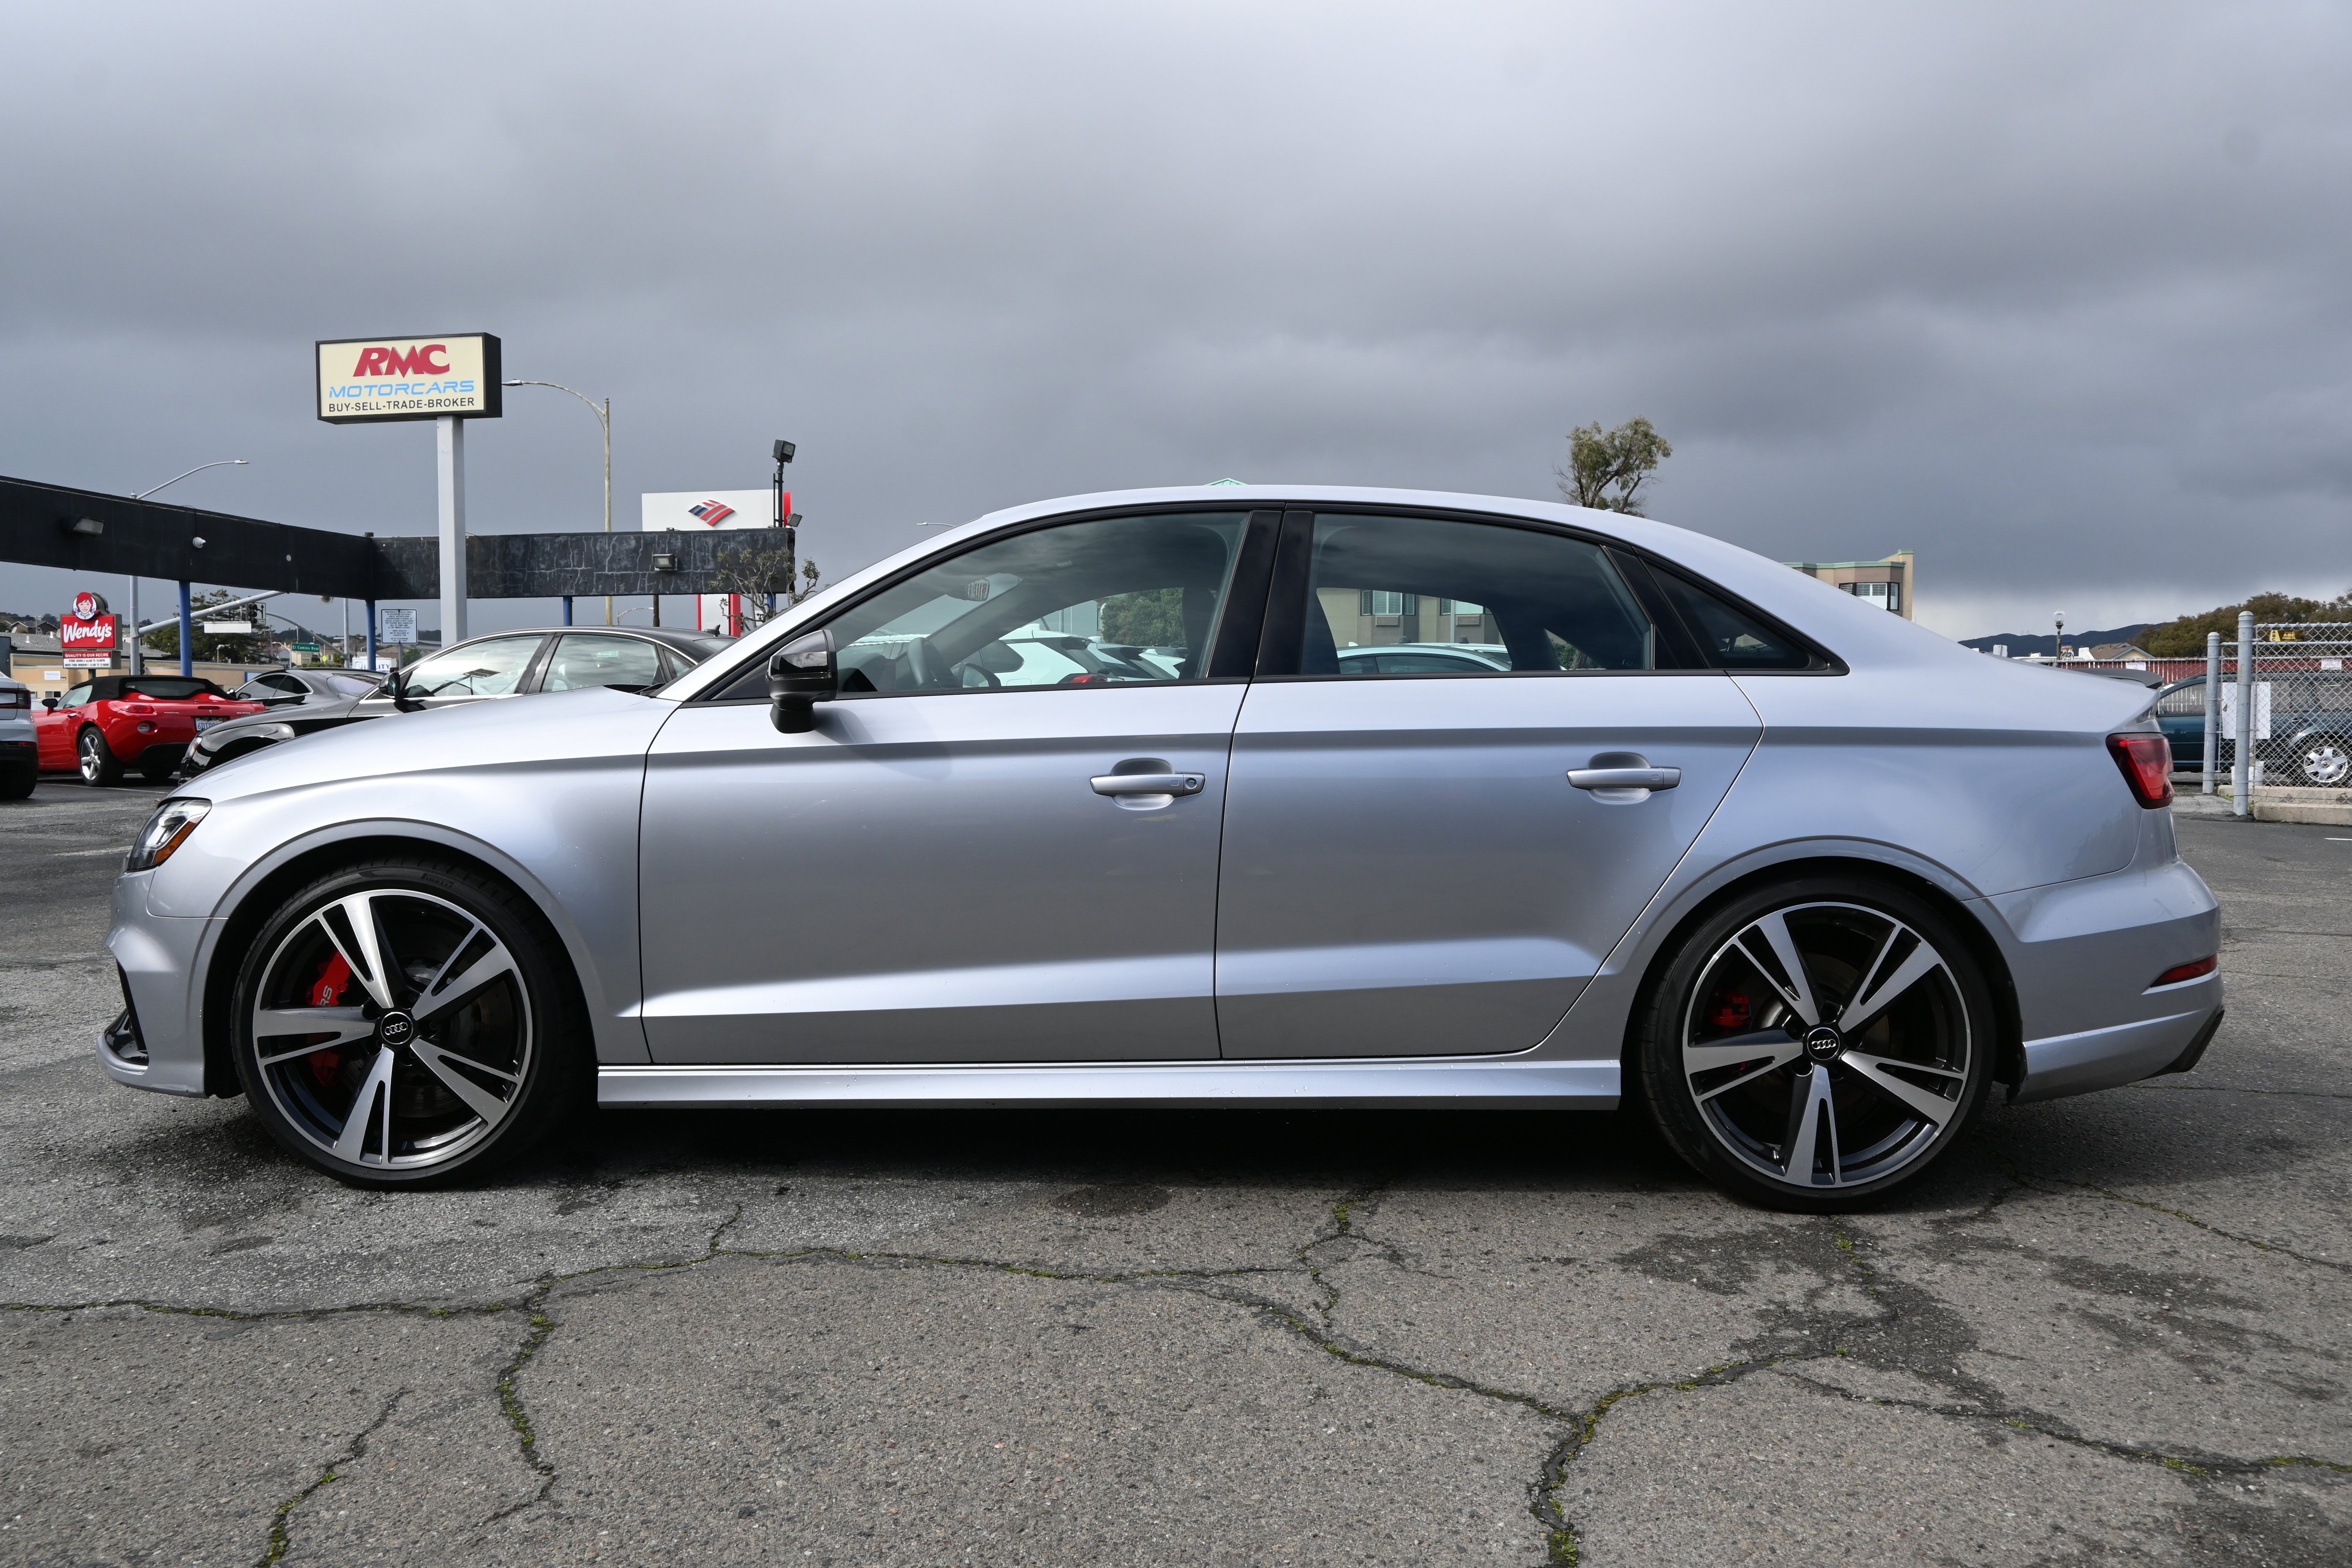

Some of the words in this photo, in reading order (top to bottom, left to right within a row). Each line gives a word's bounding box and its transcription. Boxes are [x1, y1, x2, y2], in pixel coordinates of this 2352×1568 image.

[353, 344, 450, 378] RMC
[329, 380, 474, 398] MOTORCARS
[329, 397, 474, 412] BUY-SELL-TRADE-BROKER
[63, 620, 112, 643] Wendy's
[421, 873, 455, 888] PIRELLI
